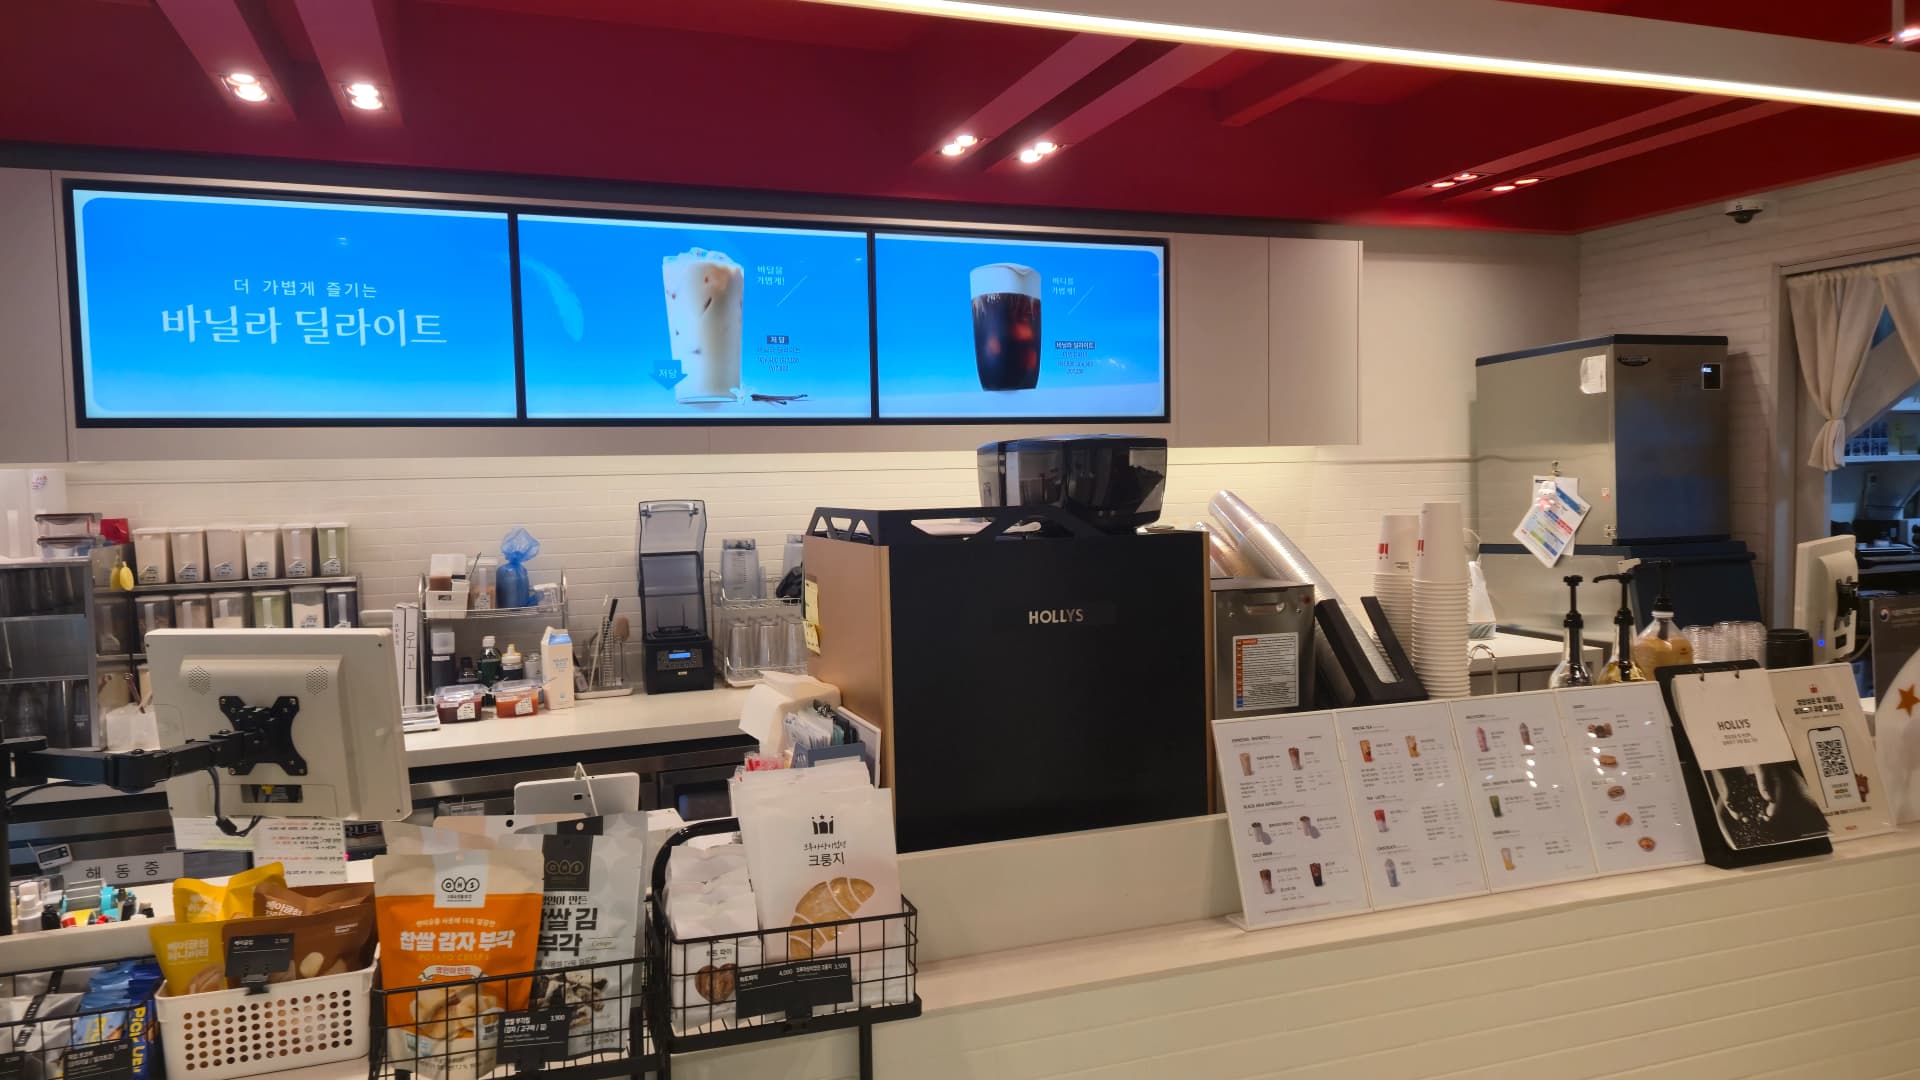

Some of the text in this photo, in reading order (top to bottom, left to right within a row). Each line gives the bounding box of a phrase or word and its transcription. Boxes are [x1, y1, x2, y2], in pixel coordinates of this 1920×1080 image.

[234, 279, 377, 298] 더 가볍게 즐기는
[161, 304, 448, 347] 바닐라 딜라이트
[1028, 608, 1084, 625] HOLLYS
[1717, 718, 1751, 731] HOLLYS
[808, 851, 845, 867] 크룽지
[575, 908, 598, 930] 김
[400, 929, 516, 952] 찹쌀 감자 부각
[537, 933, 583, 957] 부각
